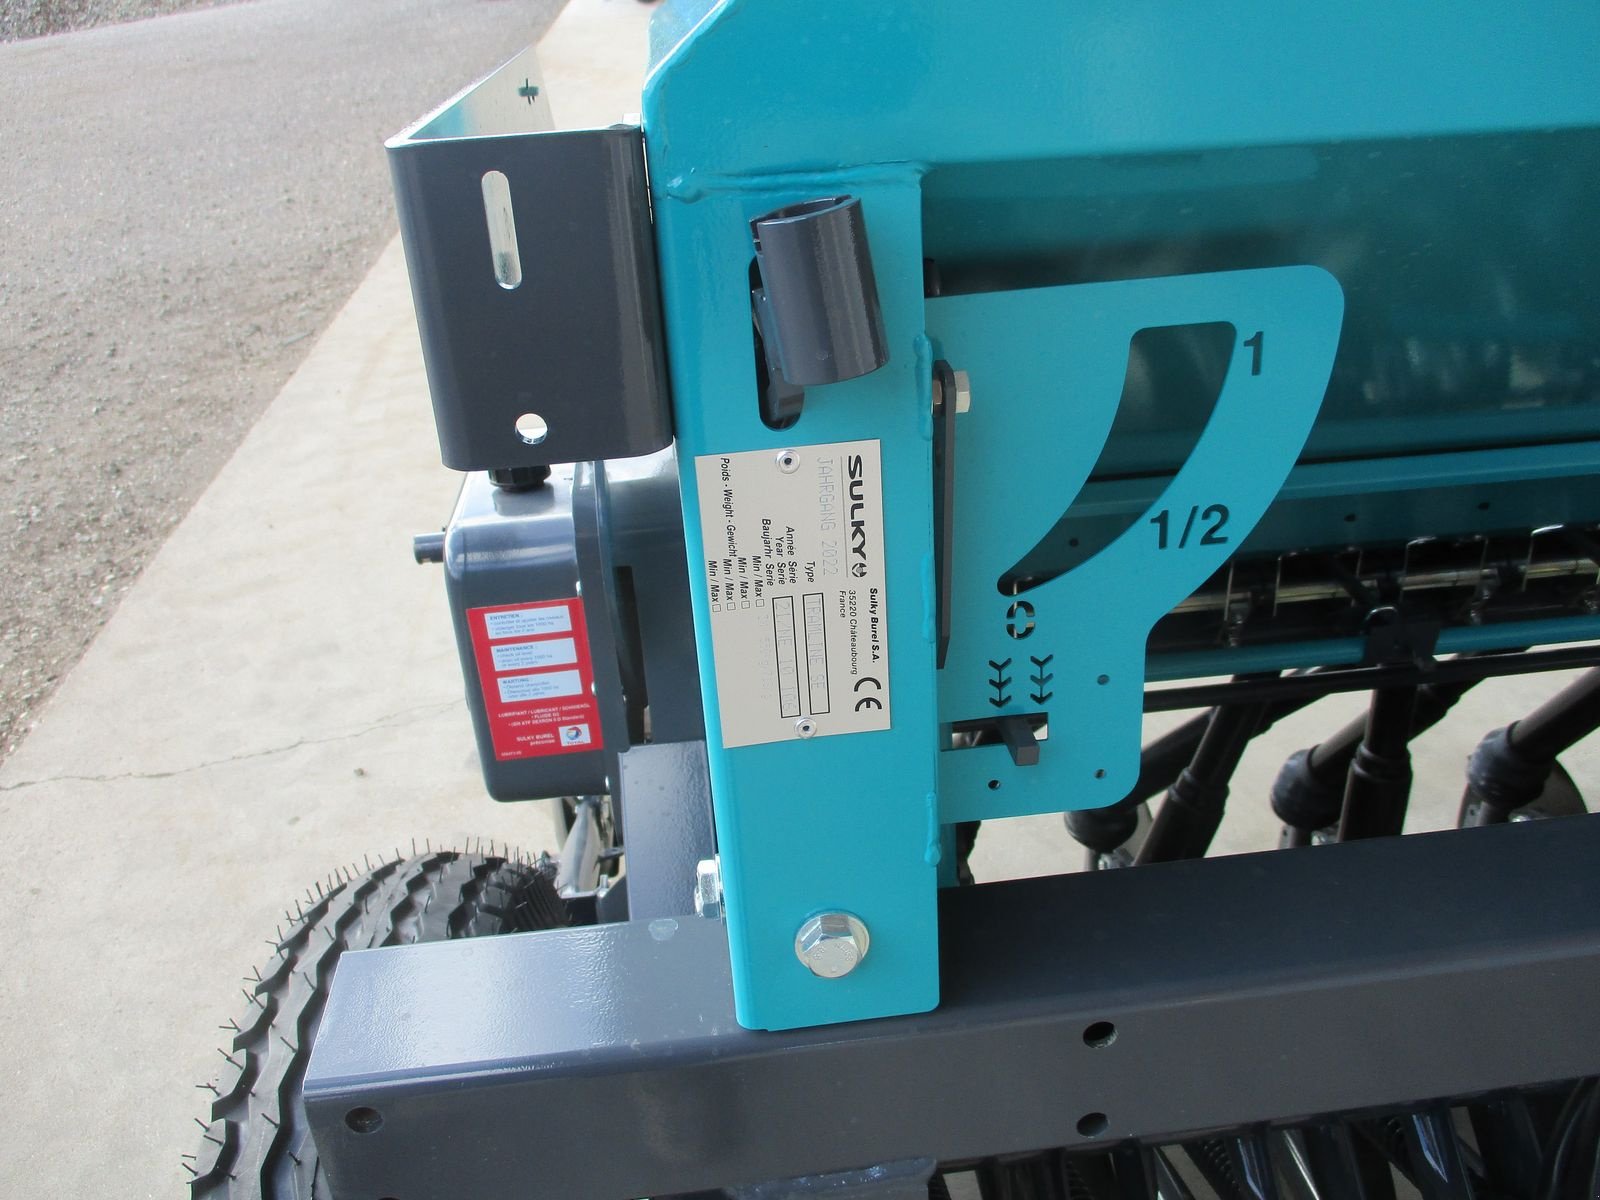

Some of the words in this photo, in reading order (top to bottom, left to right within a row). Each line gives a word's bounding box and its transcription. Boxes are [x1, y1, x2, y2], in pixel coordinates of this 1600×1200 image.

[1243, 331, 1264, 376] 1
[720, 457, 731, 481] Poids
[720, 488, 734, 518] Weight
[817, 456, 836, 531] JAHRGANG
[847, 454, 865, 561] SULKY
[759, 518, 773, 559] Baujarhr
[1150, 503, 1230, 550] 1/2
[726, 524, 737, 557] Gewicht
[775, 536, 785, 557] Year
[785, 525, 797, 555] Année
[707, 559, 717, 576] Min
[722, 557, 732, 574] Min
[737, 556, 747, 573] Min
[751, 555, 761, 571] Min
[821, 539, 838, 575] 2022
[765, 562, 775, 586] Serie
[776, 561, 787, 585] Serie
[804, 560, 816, 583] Type
[710, 583, 720, 602] Max
[724, 582, 734, 600] Max
[739, 580, 749, 599] Max
[753, 579, 763, 598] Max
[868, 587, 878, 615] Sulky
[838, 590, 847, 618] France
[848, 589, 856, 617] 35220
[805, 597, 823, 665] TRAMLINE
[870, 616, 879, 642] Burel
[871, 644, 879, 663] S.A.
[810, 673, 825, 689] SE
[853, 675, 881, 711] CE
